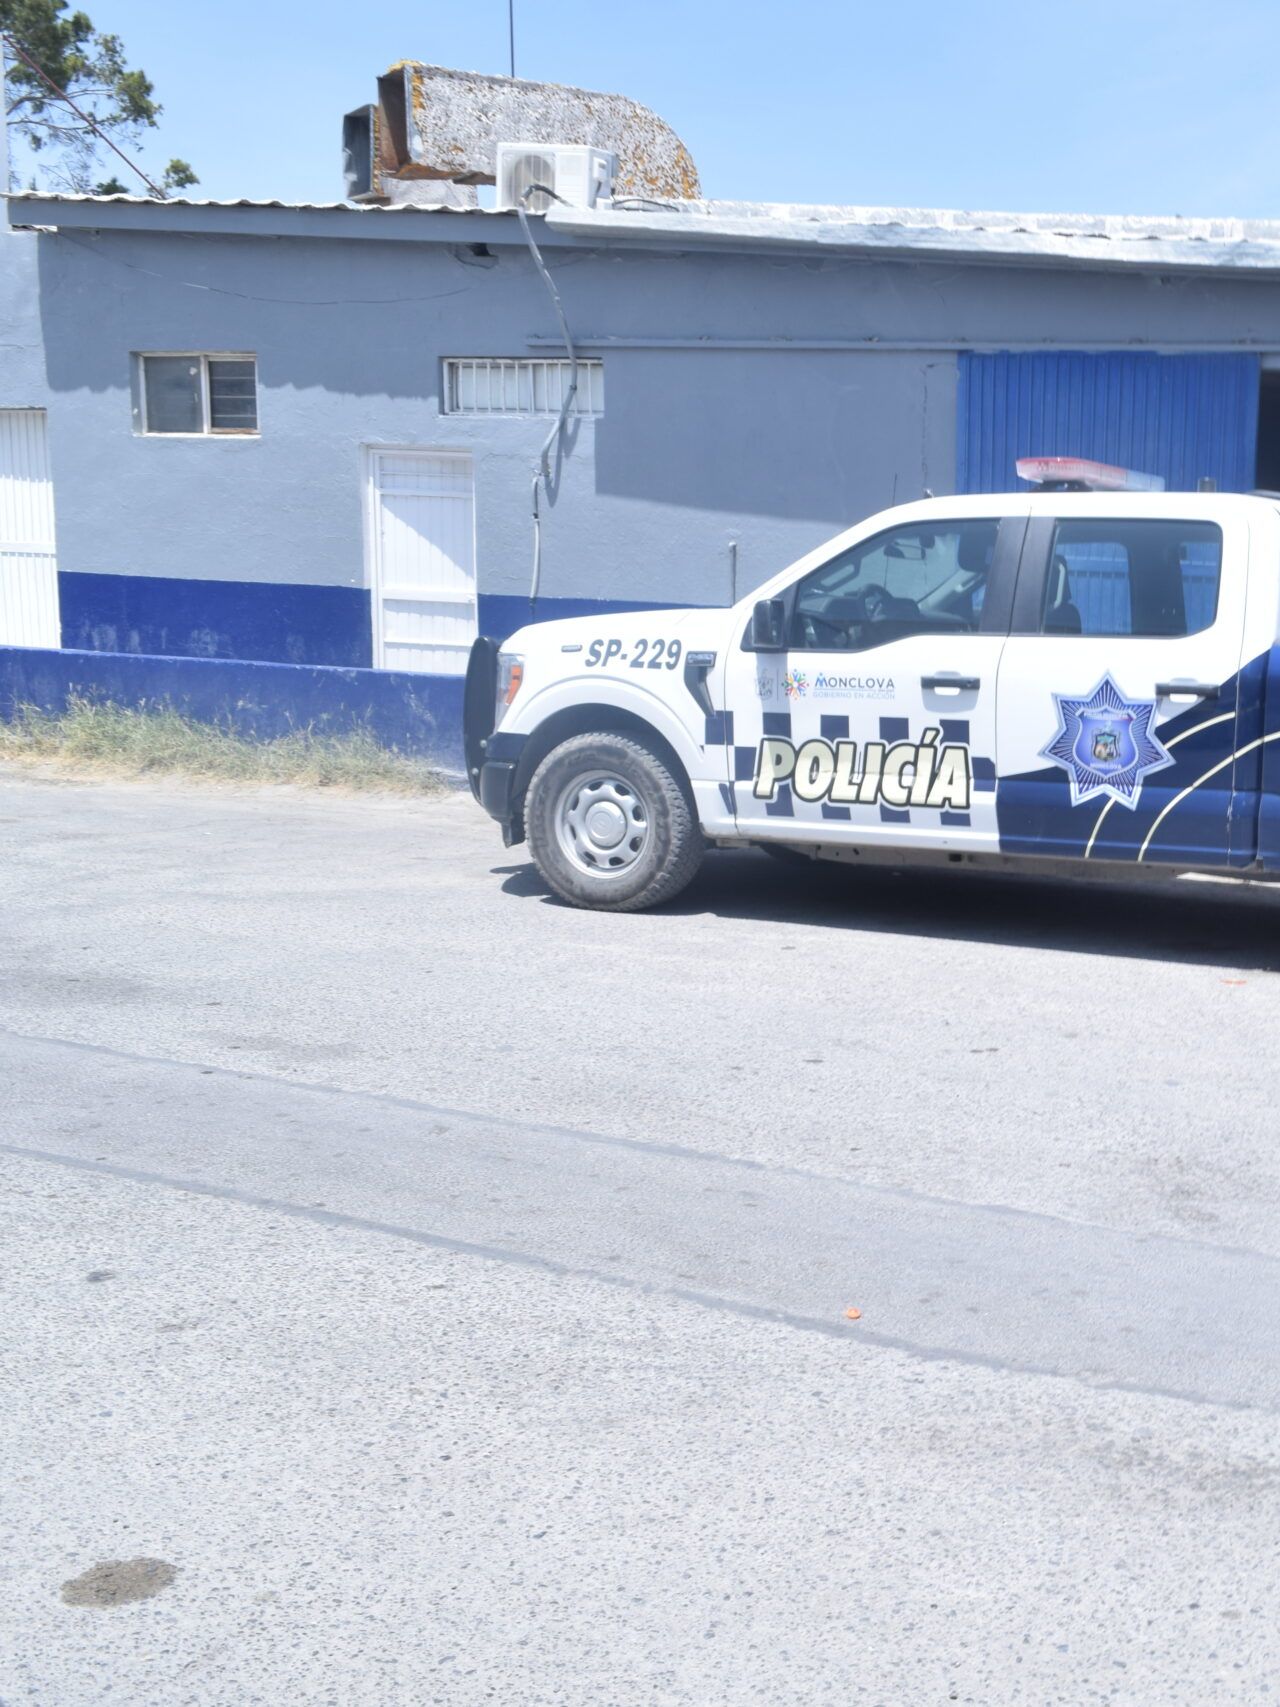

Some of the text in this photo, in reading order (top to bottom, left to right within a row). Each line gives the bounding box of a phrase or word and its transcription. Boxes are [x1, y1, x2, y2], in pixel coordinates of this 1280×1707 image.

[585, 638, 682, 670] SP-229
[814, 674, 895, 689] MONCLOVA
[753, 727, 970, 809] POLICÍA
